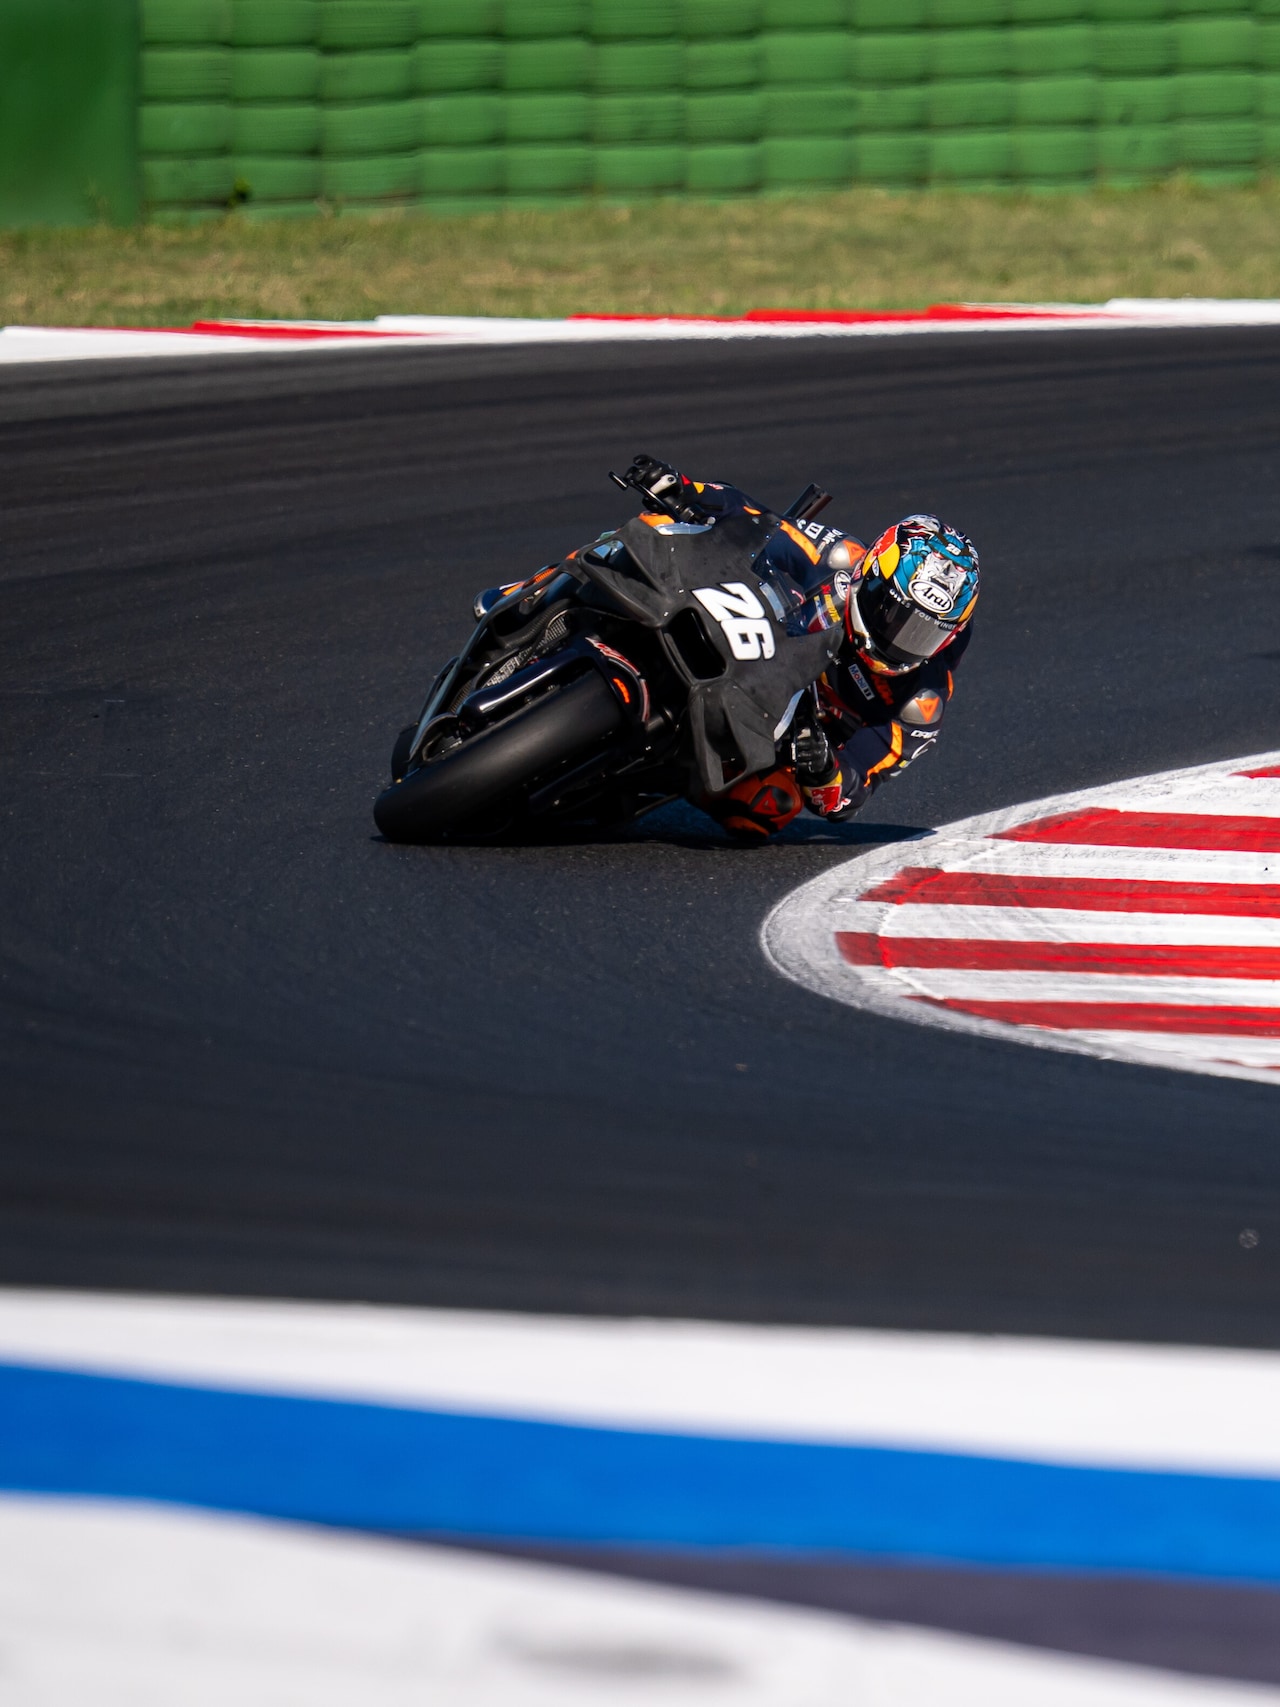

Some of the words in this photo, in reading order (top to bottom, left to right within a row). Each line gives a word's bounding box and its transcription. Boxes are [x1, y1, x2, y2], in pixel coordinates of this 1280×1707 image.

[919, 585, 950, 609] Arai
[692, 582, 775, 660] 26
[914, 608, 930, 622] YOU
[849, 664, 867, 690] Mobil
